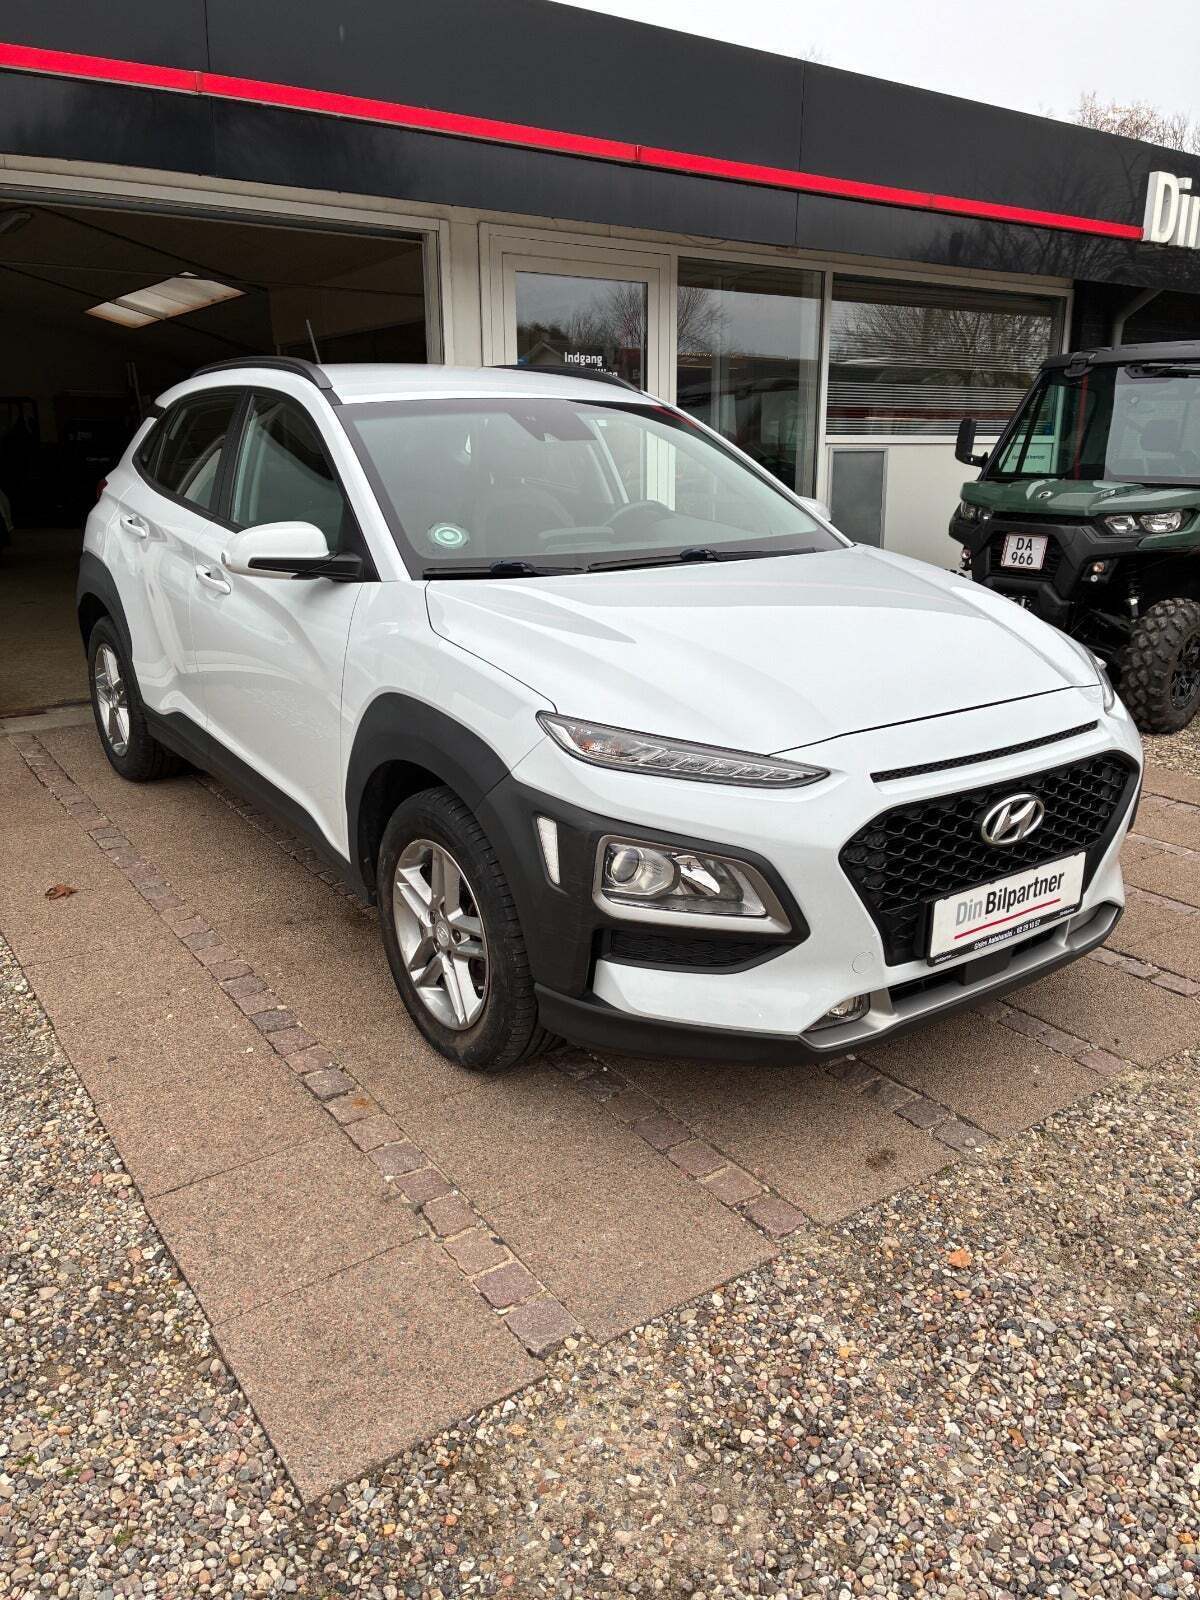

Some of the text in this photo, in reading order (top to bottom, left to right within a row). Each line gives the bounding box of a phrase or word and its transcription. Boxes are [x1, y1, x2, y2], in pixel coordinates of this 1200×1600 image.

[564, 352, 603, 366] Indgang
[1016, 537, 1033, 551] DA
[1011, 552, 1033, 566] 966
